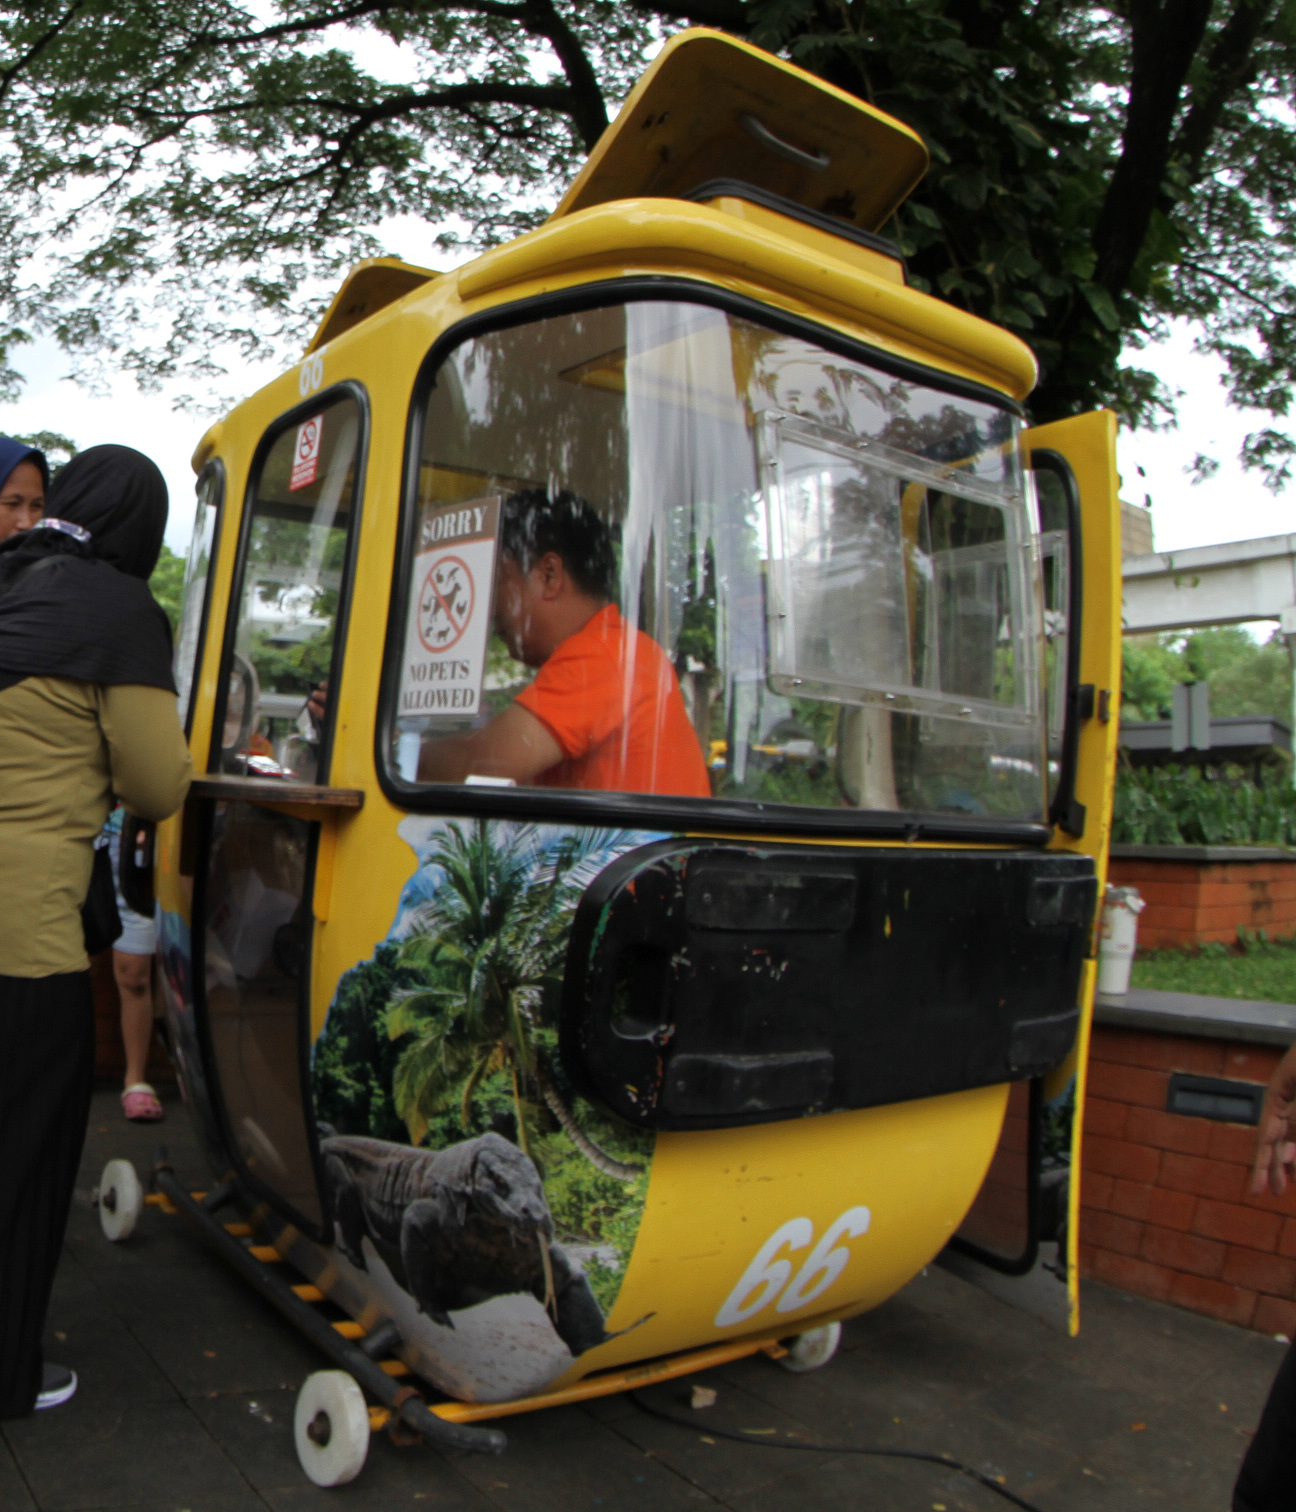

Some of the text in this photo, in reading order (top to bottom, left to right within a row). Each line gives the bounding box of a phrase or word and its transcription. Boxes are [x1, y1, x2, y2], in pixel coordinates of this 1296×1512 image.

[421, 506, 488, 545] SORRY
[410, 659, 470, 682] NO PETS
[402, 688, 475, 709] ALLOWED
[714, 1205, 871, 1328] 66
